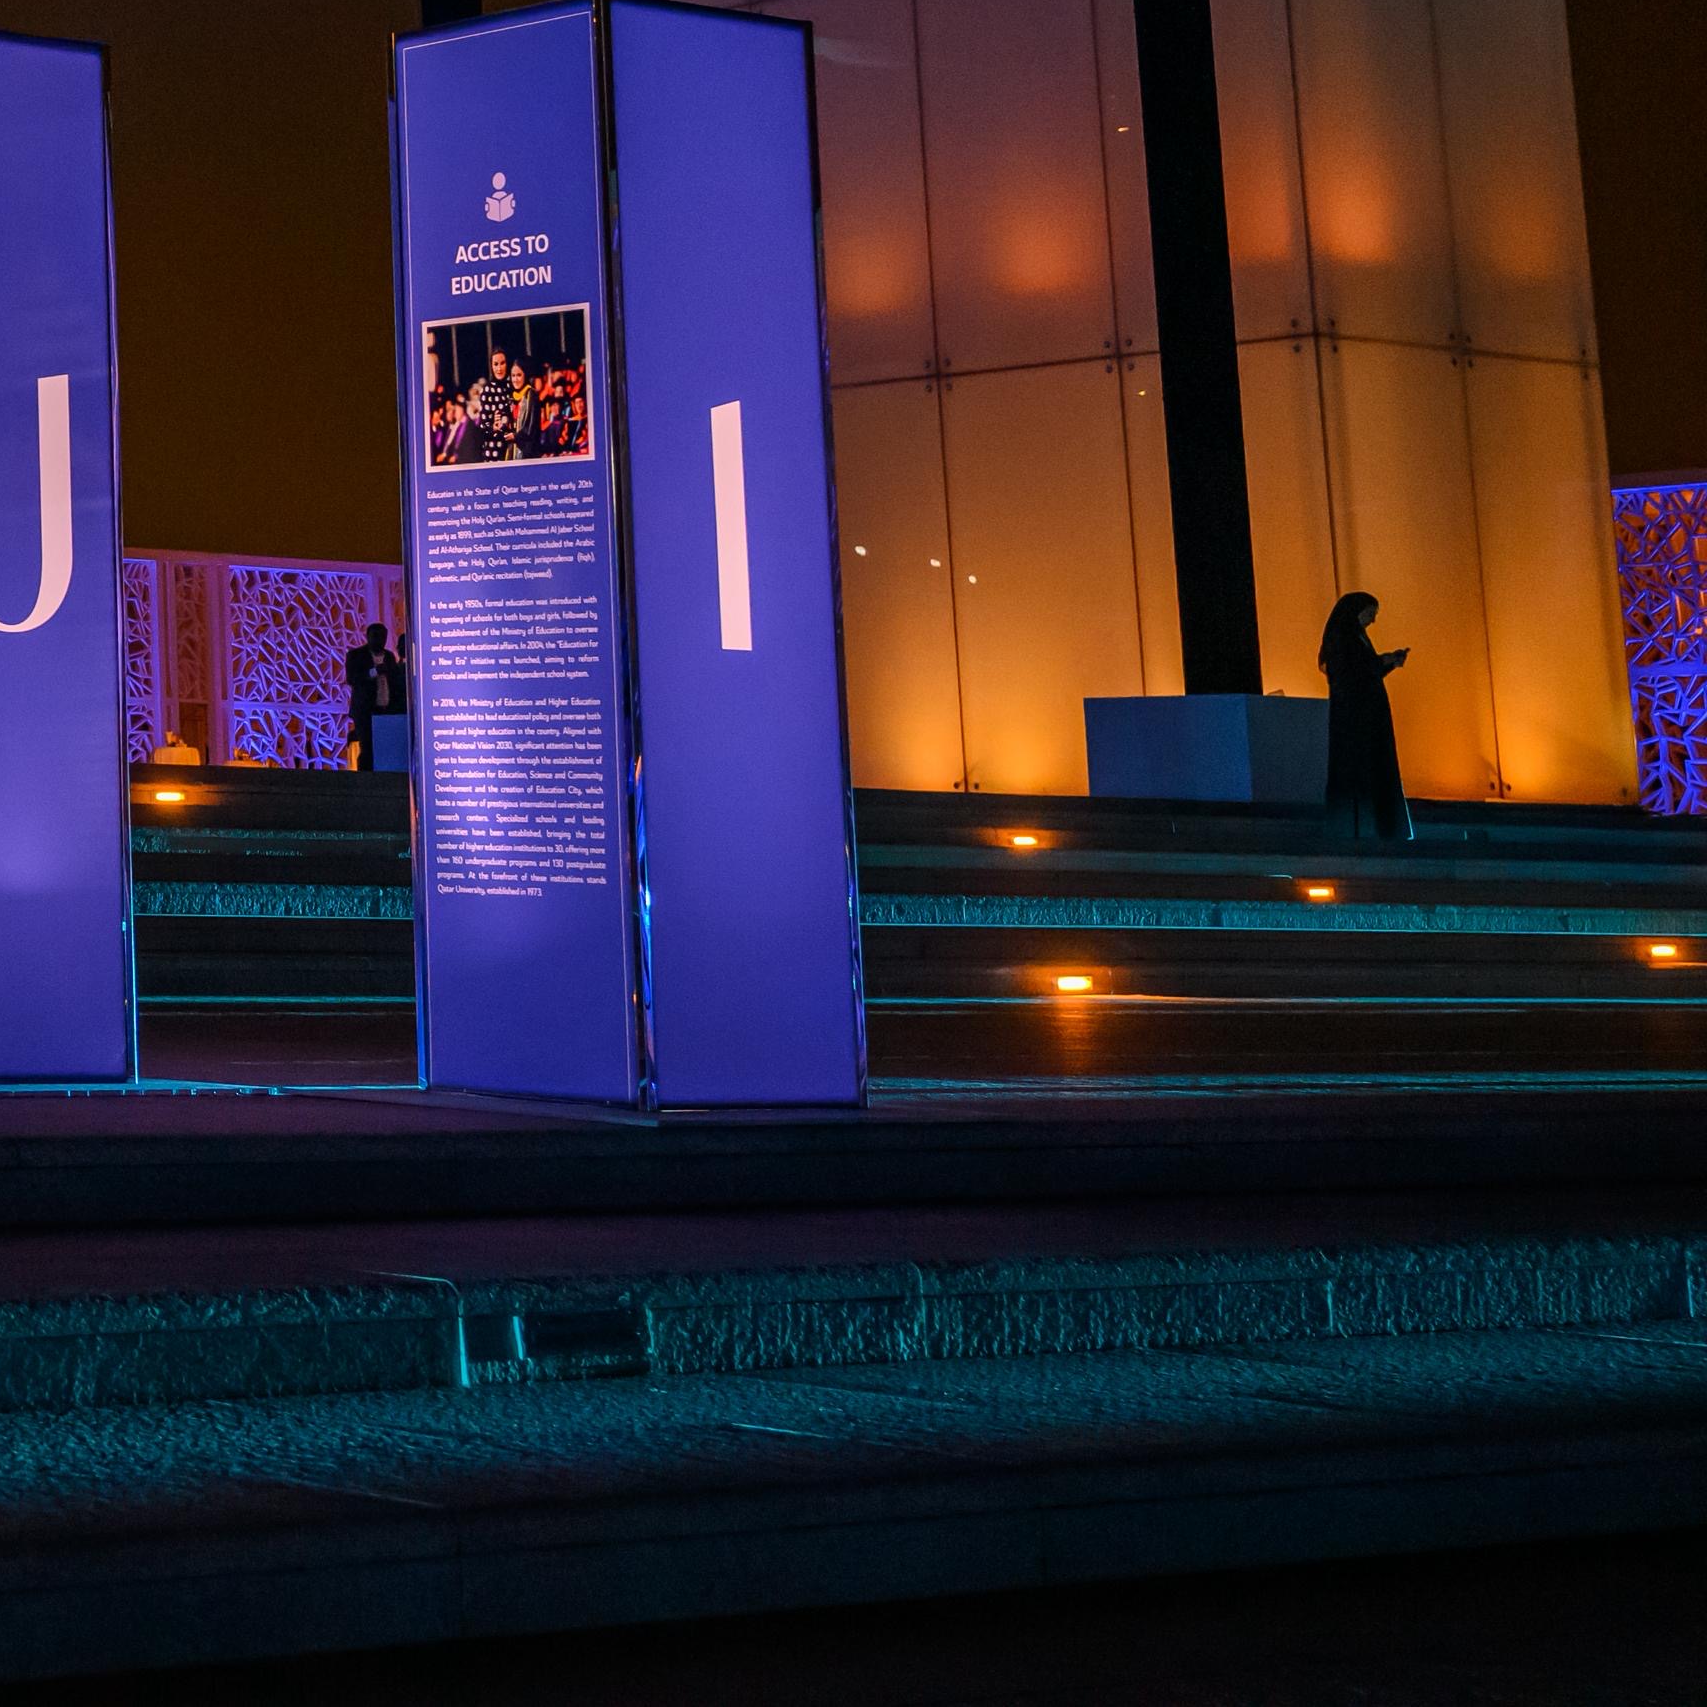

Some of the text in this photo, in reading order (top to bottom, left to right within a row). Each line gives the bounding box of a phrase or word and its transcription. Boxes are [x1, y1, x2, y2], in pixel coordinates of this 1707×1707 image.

[456, 234, 548, 263] ACCESS TO
[451, 265, 552, 296] EDUCATION
[427, 491, 455, 499] Education
[493, 486, 500, 494] of
[501, 486, 519, 495] Qatar
[521, 485, 539, 494] began
[561, 482, 576, 491] early
[474, 502, 490, 510] focus
[502, 500, 527, 508] teaching
[582, 495, 594, 503] and
[512, 542, 537, 550] curricula
[538, 540, 562, 548] included
[448, 601, 463, 610] early
[485, 599, 504, 607] formal
[549, 596, 582, 604] introduced
[544, 657, 565, 665] aiming
[578, 654, 599, 662] reform
[470, 699, 494, 708] Ministry
[496, 698, 502, 706] of
[504, 698, 533, 706] Education
[548, 698, 568, 707] Higher
[571, 697, 601, 705] Education
[433, 728, 455, 737] general
[455, 727, 467, 735] and
[468, 727, 486, 737] higher
[524, 727, 535, 735] the
[563, 727, 586, 737] Aligned
[588, 727, 602, 735] with
[434, 741, 451, 751] Qatar
[515, 741, 545, 751] significant
[434, 770, 452, 779] Qatar
[453, 770, 485, 778] Foundation
[487, 770, 496, 778] for
[530, 770, 553, 779] Science
[554, 771, 566, 779] and
[567, 771, 603, 781] Community
[435, 784, 472, 793] Development
[488, 785, 498, 793] the
[527, 785, 533, 793] of
[536, 785, 566, 794] Education
[437, 884, 454, 894] Qatar
[487, 887, 520, 895] established
